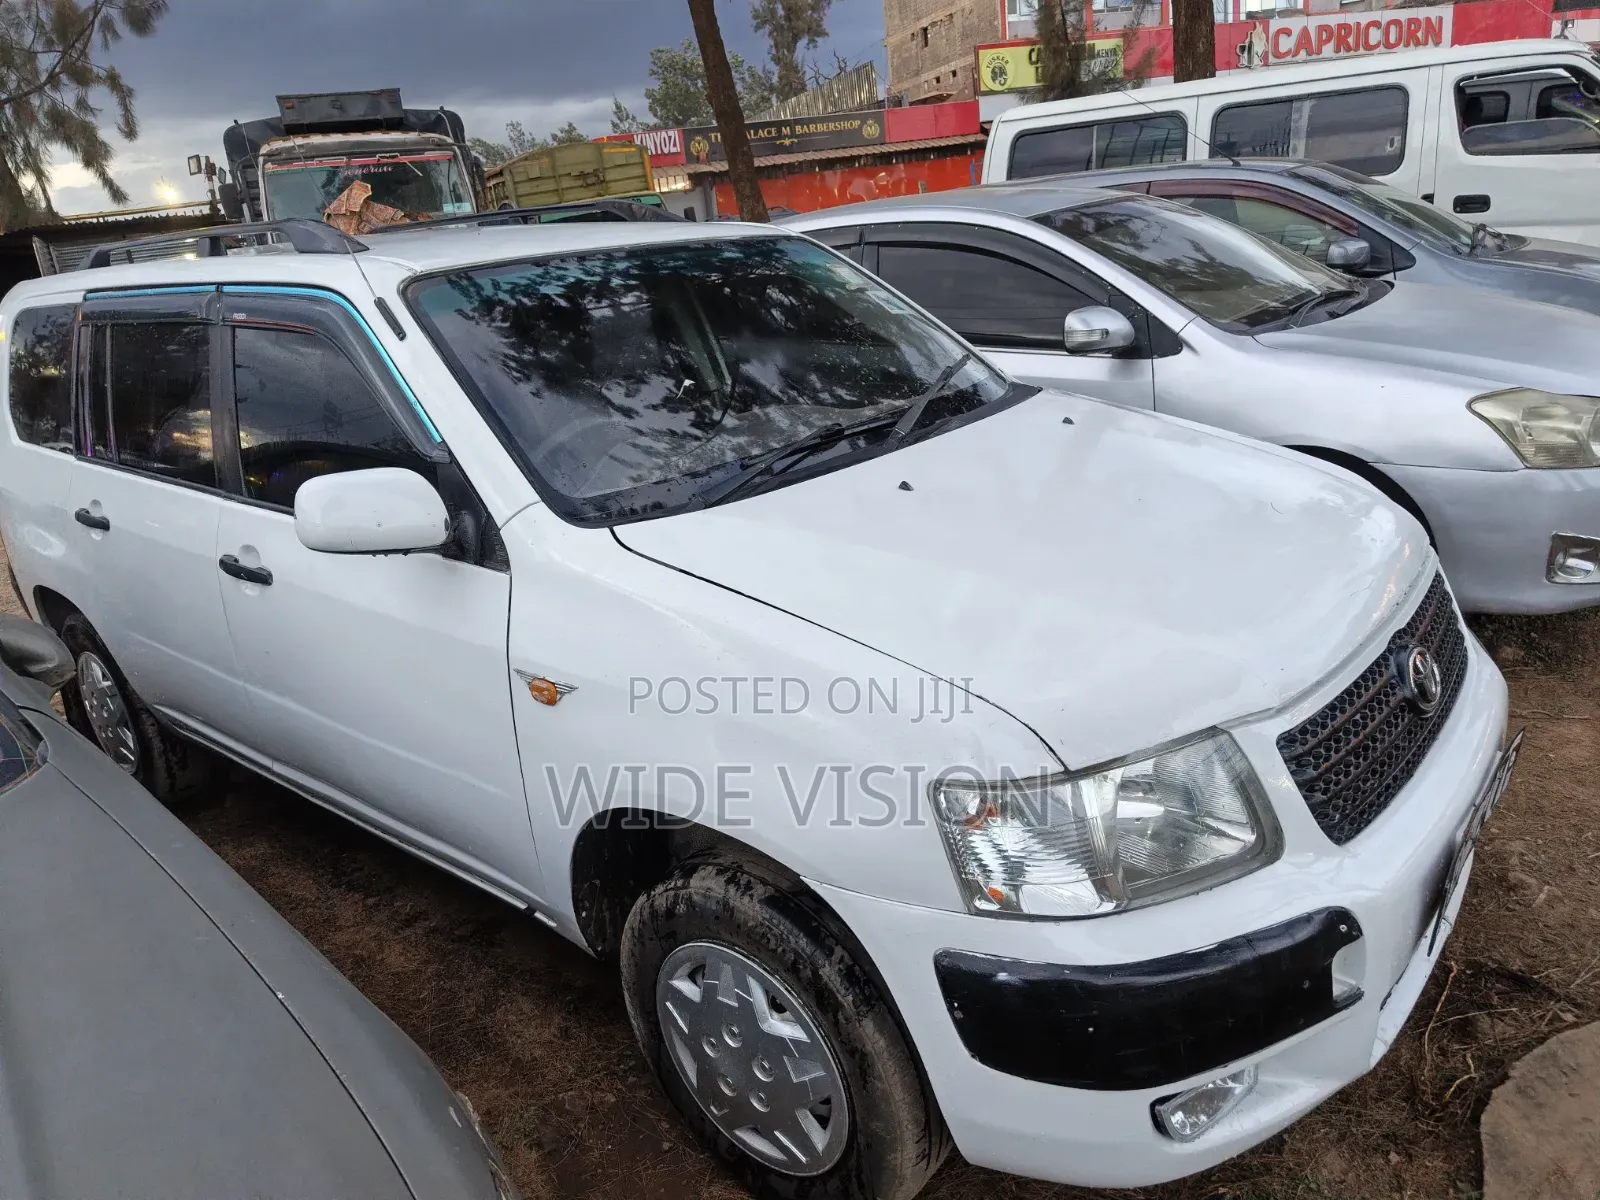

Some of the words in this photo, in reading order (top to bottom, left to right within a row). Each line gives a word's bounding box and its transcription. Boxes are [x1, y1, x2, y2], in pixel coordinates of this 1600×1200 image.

[1272, 16, 1444, 59] CAPRICORN
[986, 55, 1010, 69] TUSKER
[781, 126, 791, 136] M
[795, 119, 861, 135] BARBERSHOP
